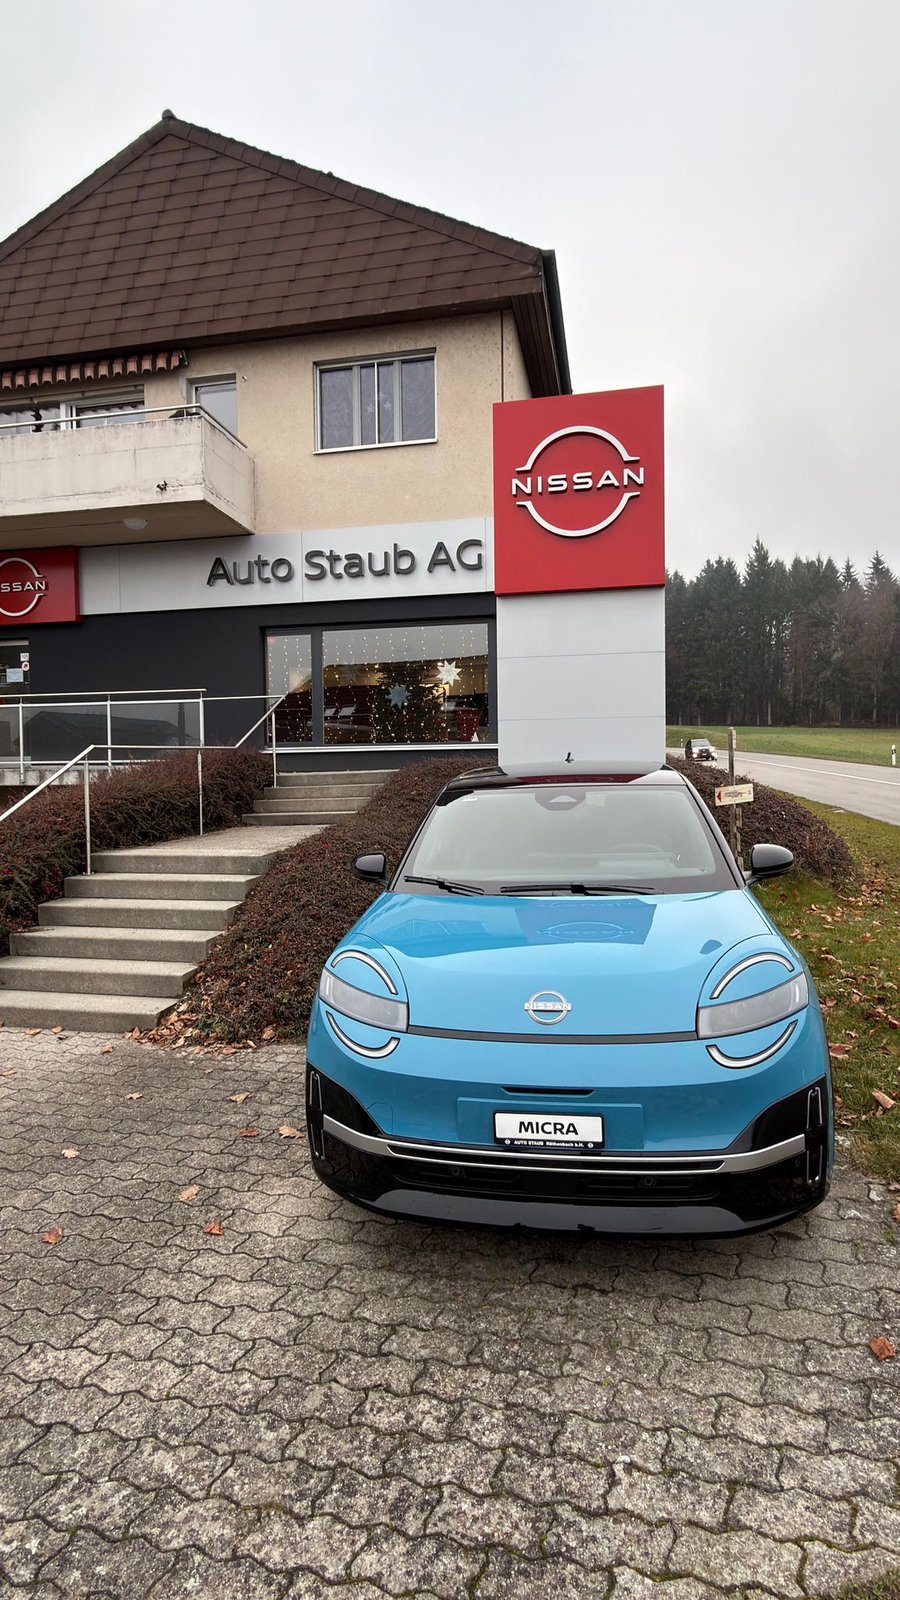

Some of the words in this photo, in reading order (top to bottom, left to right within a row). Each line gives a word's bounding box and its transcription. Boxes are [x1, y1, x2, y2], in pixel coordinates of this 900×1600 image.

[511, 467, 645, 496] NISSAN
[206, 554, 295, 586] Auto
[304, 543, 416, 580] Staub
[427, 538, 483, 573] AG
[0, 581, 46, 592] SSAN
[524, 1002, 571, 1010] NISSAN
[518, 1121, 579, 1135] MICRA
